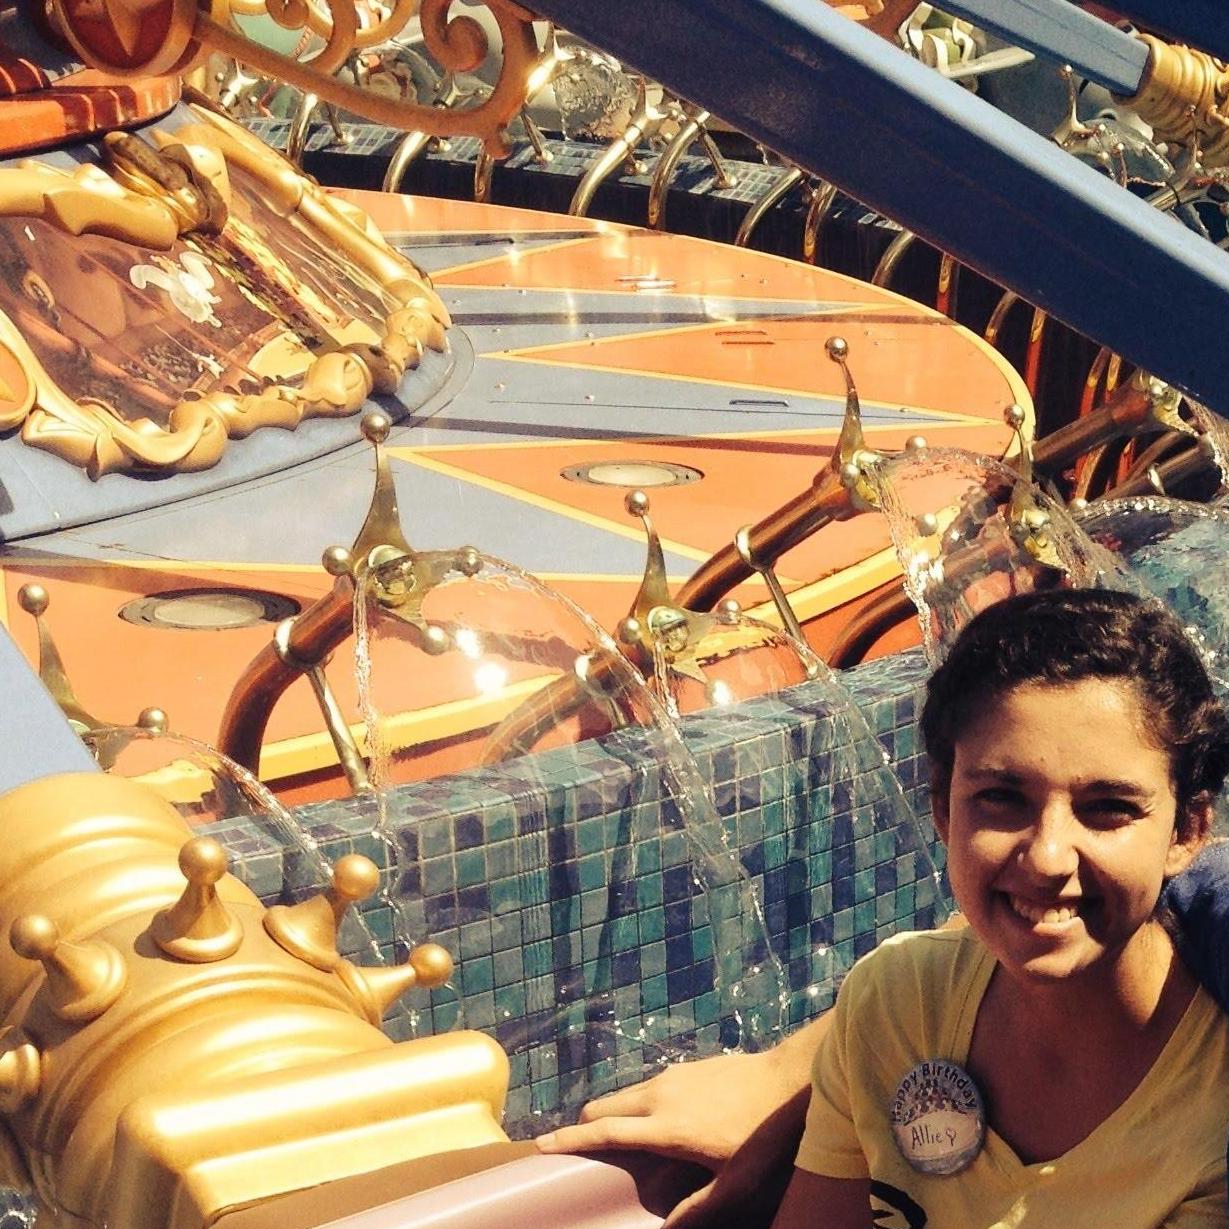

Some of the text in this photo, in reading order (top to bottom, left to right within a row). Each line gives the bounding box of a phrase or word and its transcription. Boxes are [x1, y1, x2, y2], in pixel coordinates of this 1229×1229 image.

[891, 1063, 977, 1122] Happy Birthday
[911, 1124, 943, 1149] Allie
